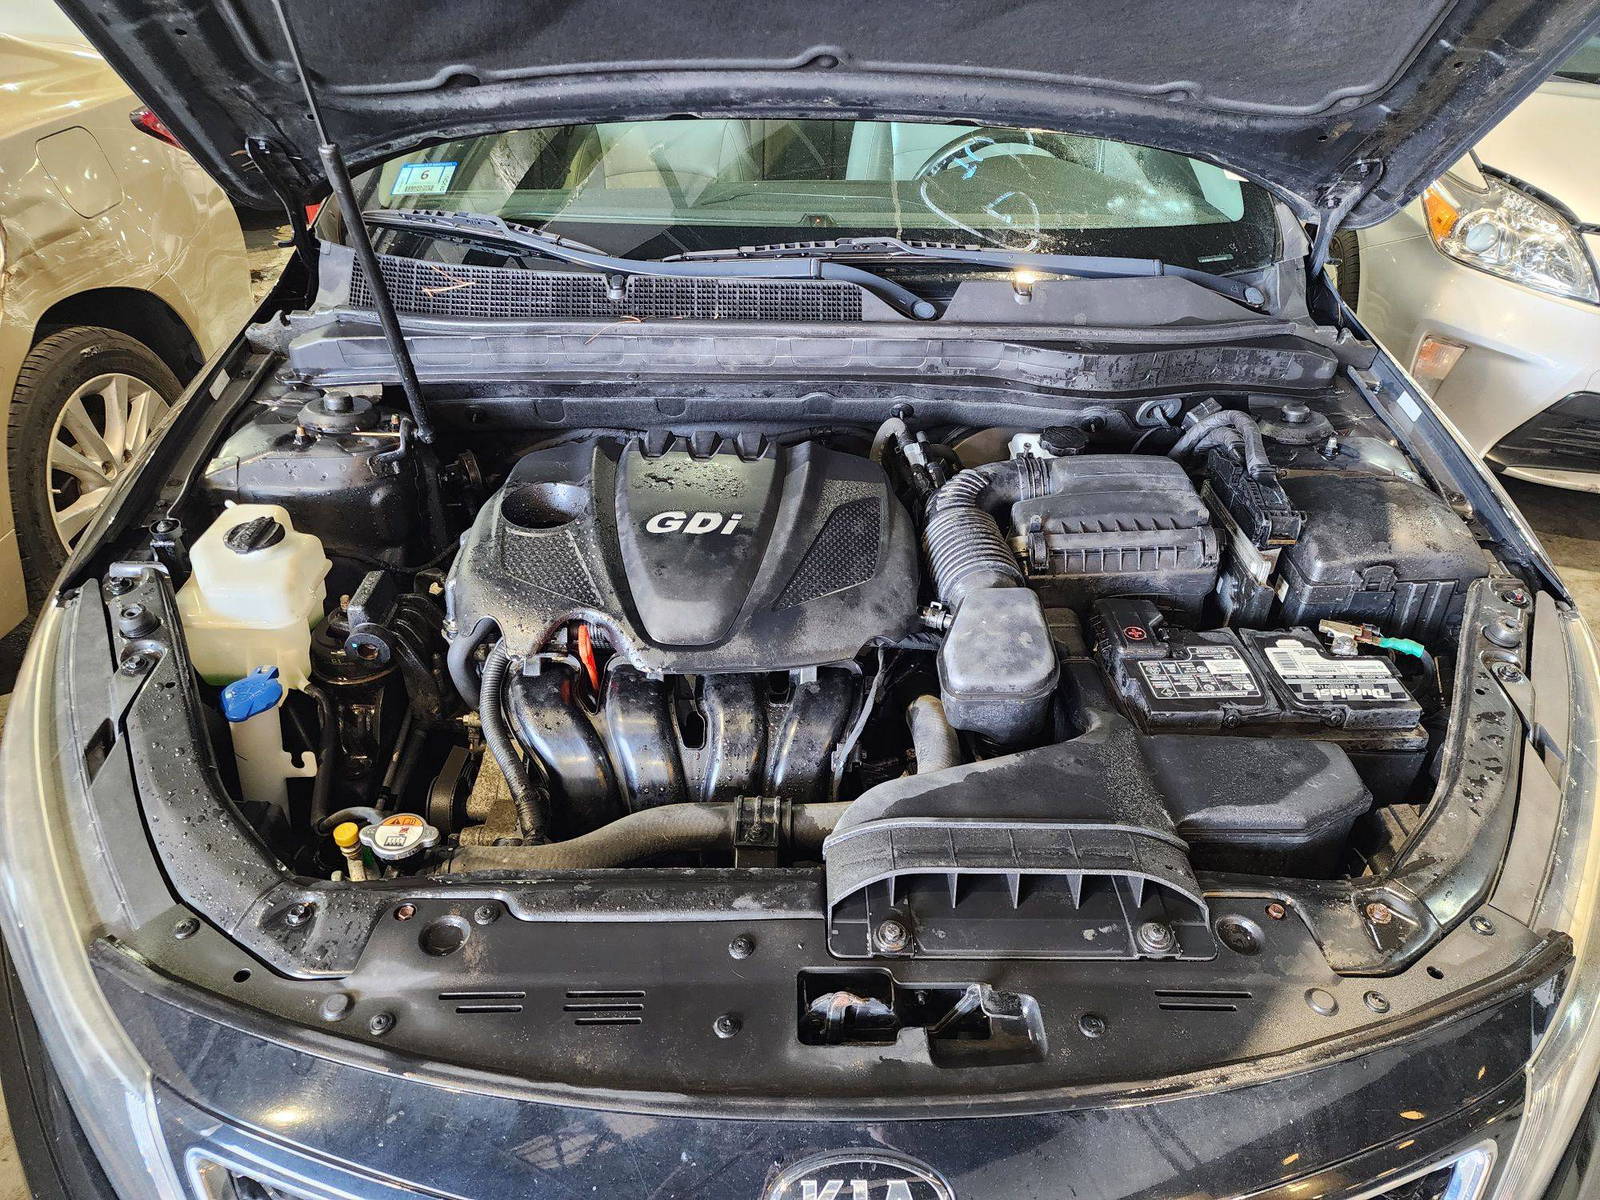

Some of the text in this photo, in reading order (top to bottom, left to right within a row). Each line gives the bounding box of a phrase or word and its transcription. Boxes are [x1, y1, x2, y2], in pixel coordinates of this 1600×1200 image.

[420, 170, 430, 180] 6
[646, 511, 743, 535] GDi
[1312, 688, 1391, 699] Duralast
[801, 1179, 914, 1200] KIA
